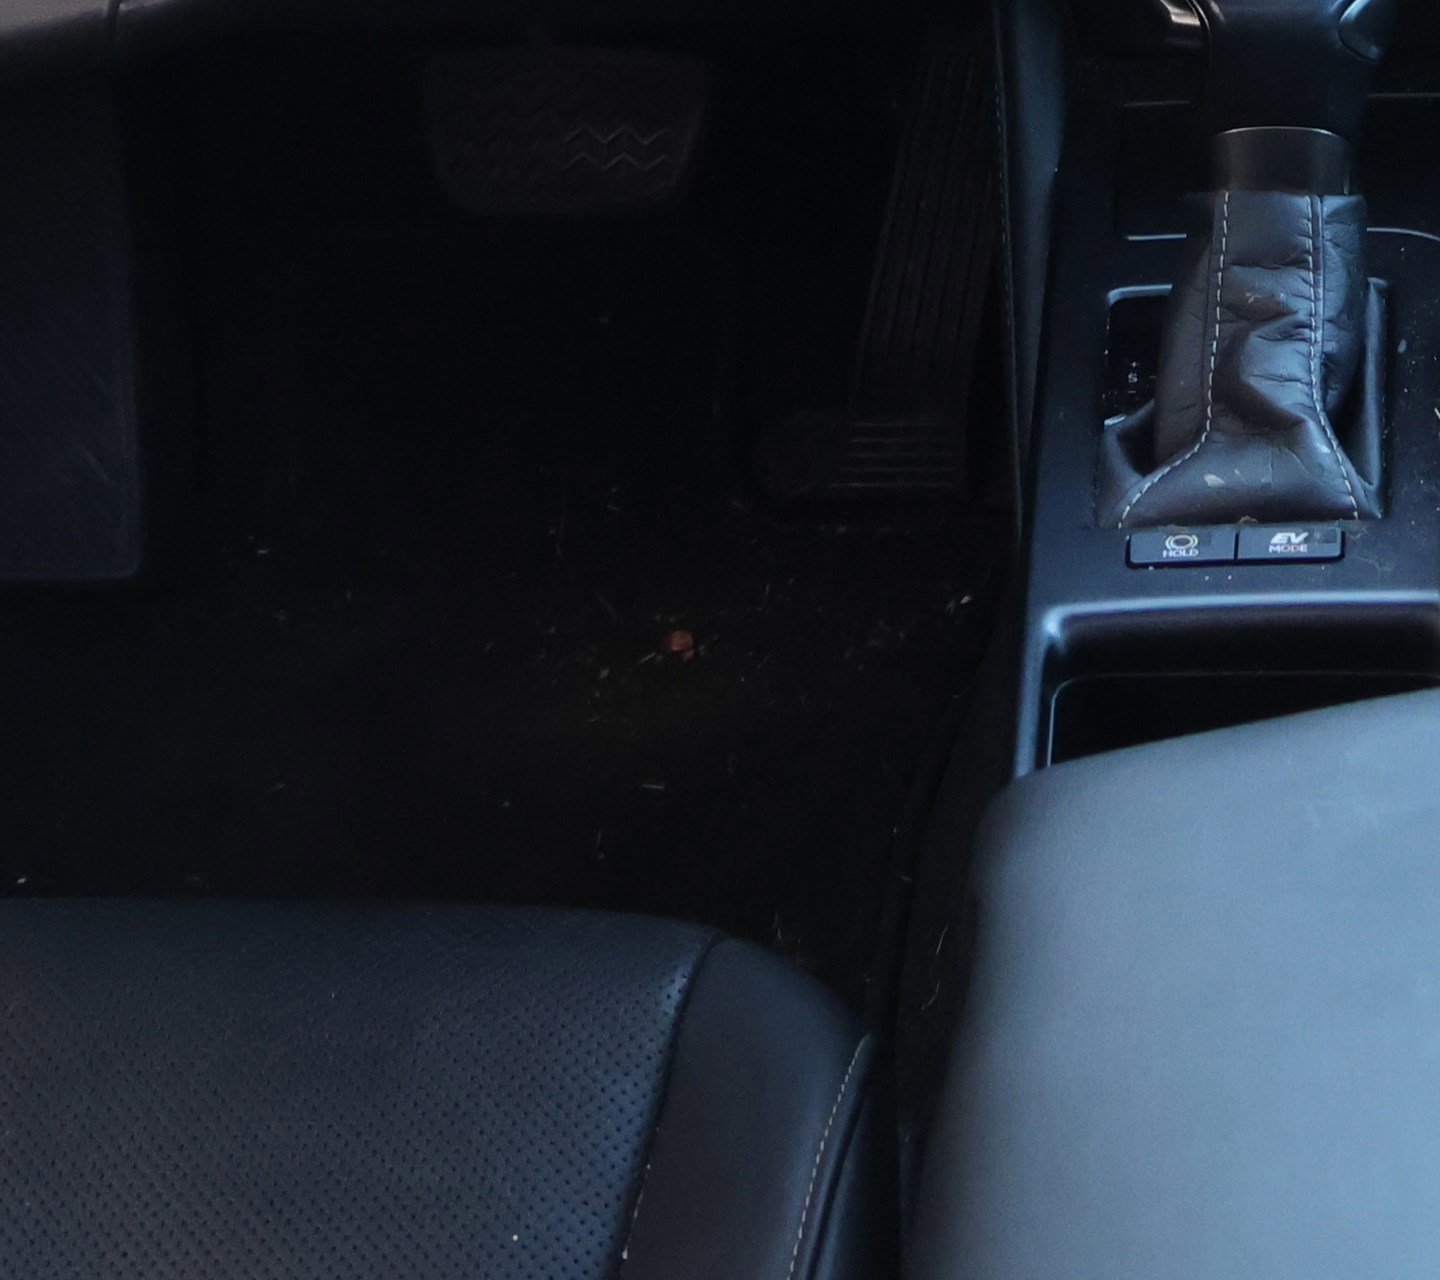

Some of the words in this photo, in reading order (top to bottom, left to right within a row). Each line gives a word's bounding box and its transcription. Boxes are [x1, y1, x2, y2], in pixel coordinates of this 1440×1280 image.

[1270, 532, 1310, 544] EV
[1162, 548, 1199, 558] HOLD
[1268, 544, 1308, 553] MODE
